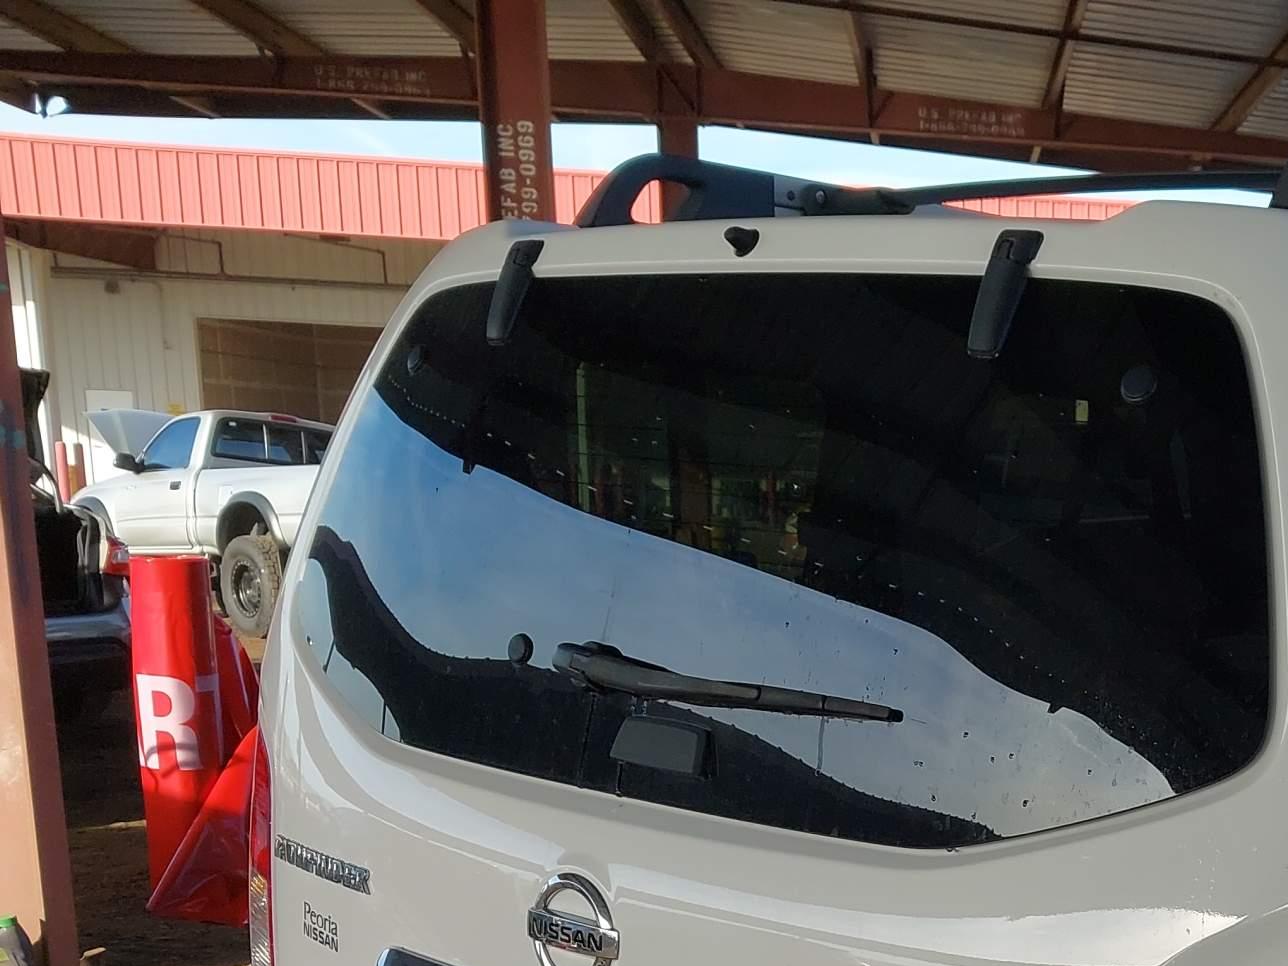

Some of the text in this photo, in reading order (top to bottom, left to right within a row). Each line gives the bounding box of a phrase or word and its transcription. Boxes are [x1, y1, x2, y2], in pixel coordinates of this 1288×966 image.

[303, 900, 338, 938] Peoria
[303, 920, 339, 953] NISSAN
[531, 915, 604, 953] NISSAN
